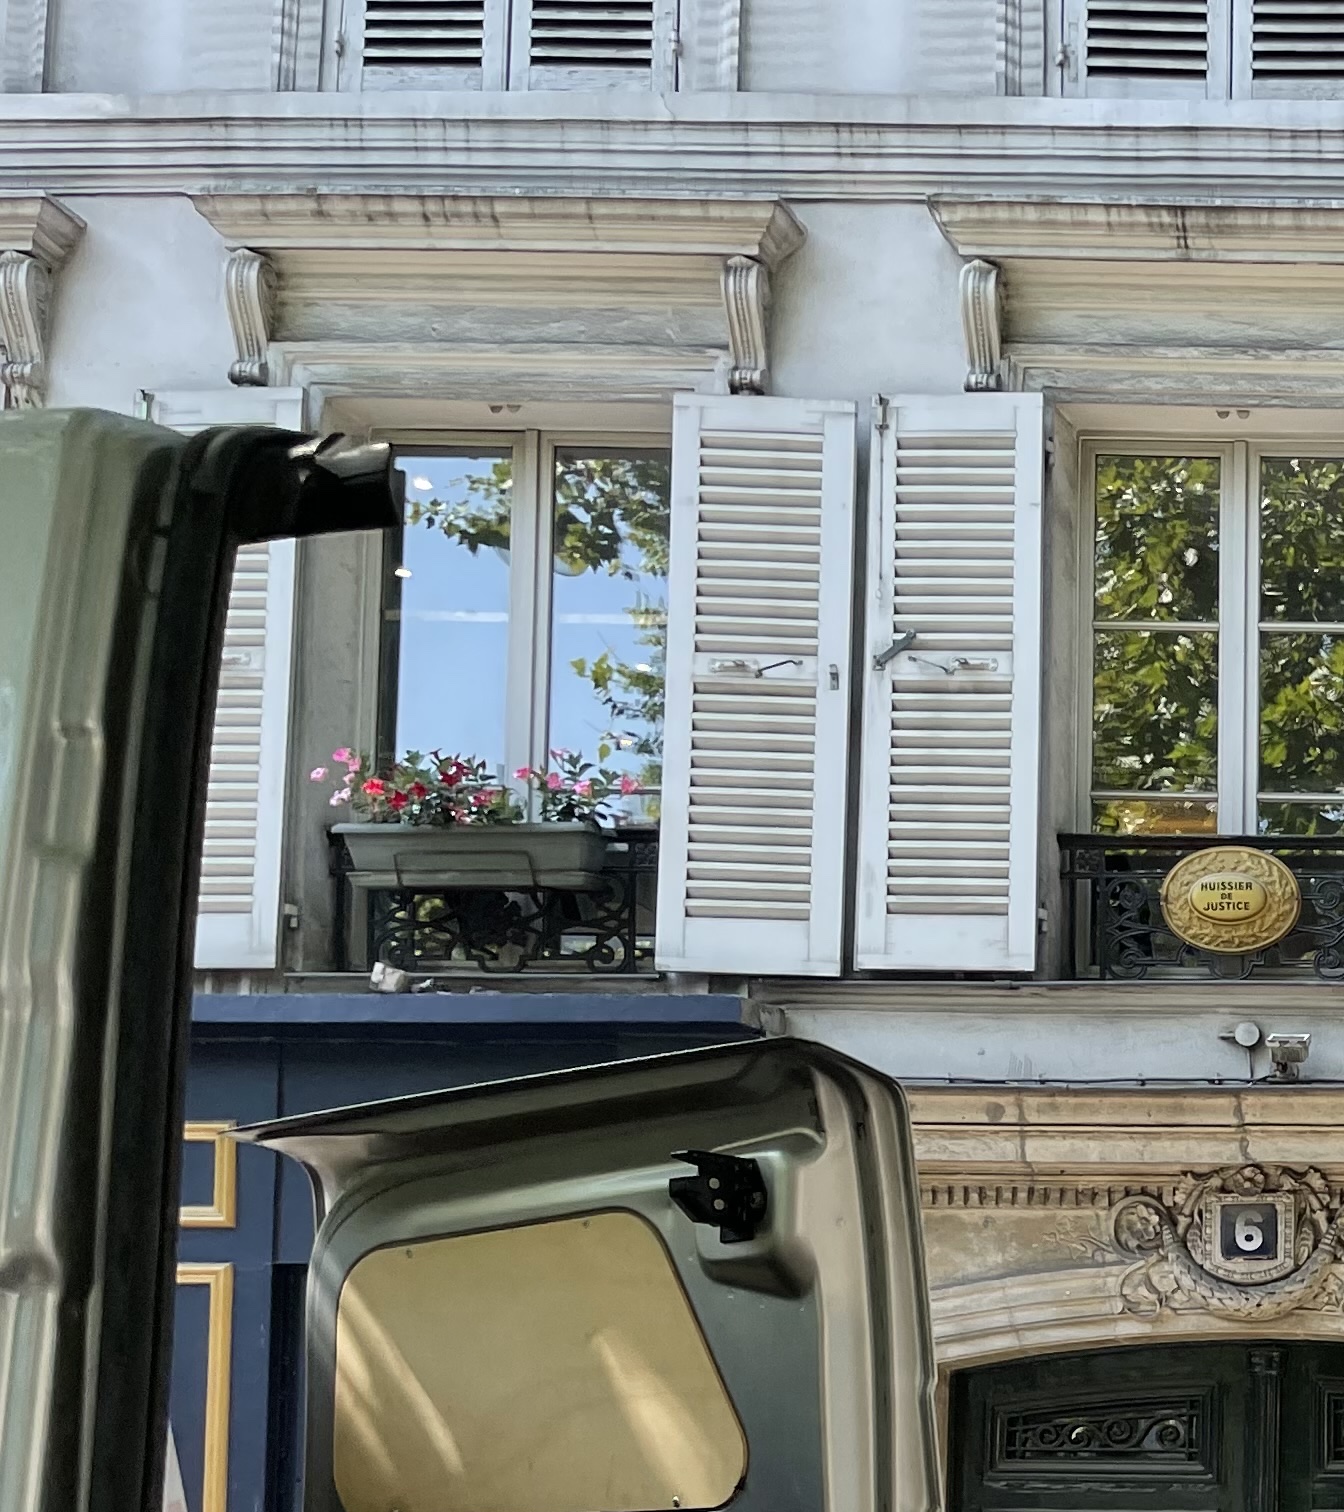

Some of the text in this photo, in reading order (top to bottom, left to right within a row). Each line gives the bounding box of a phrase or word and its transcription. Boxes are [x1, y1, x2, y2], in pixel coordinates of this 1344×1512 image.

[1201, 882, 1253, 891] HUISSIER
[1203, 902, 1250, 911] JUSTICE
[1235, 1210, 1263, 1252] 6
